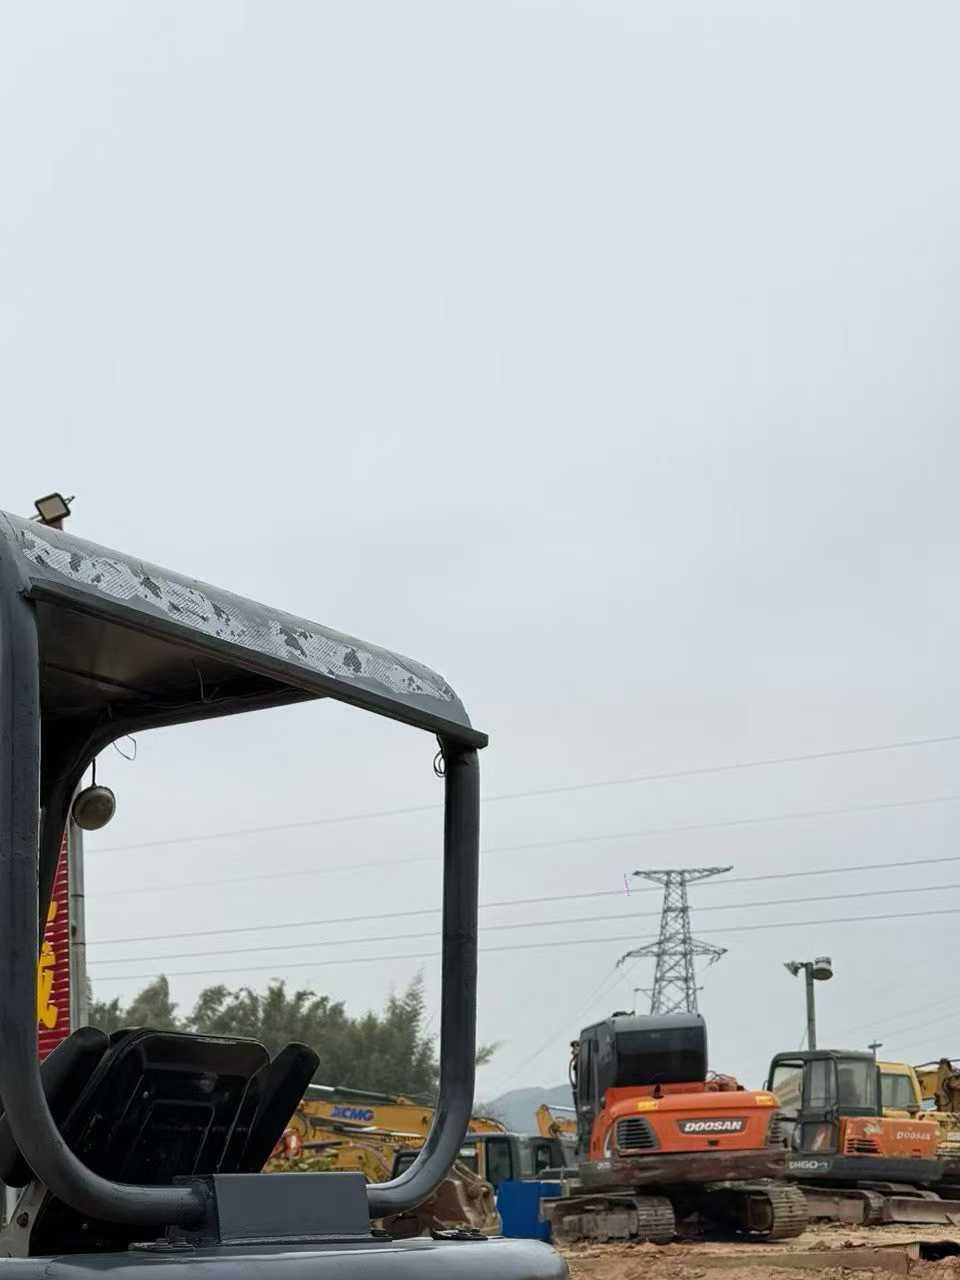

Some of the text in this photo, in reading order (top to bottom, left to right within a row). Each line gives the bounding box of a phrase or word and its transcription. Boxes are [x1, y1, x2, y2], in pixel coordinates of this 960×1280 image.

[330, 1106, 374, 1121] XCMG
[684, 1121, 742, 1132] DOOSAN
[896, 1130, 931, 1140] DOOSAN
